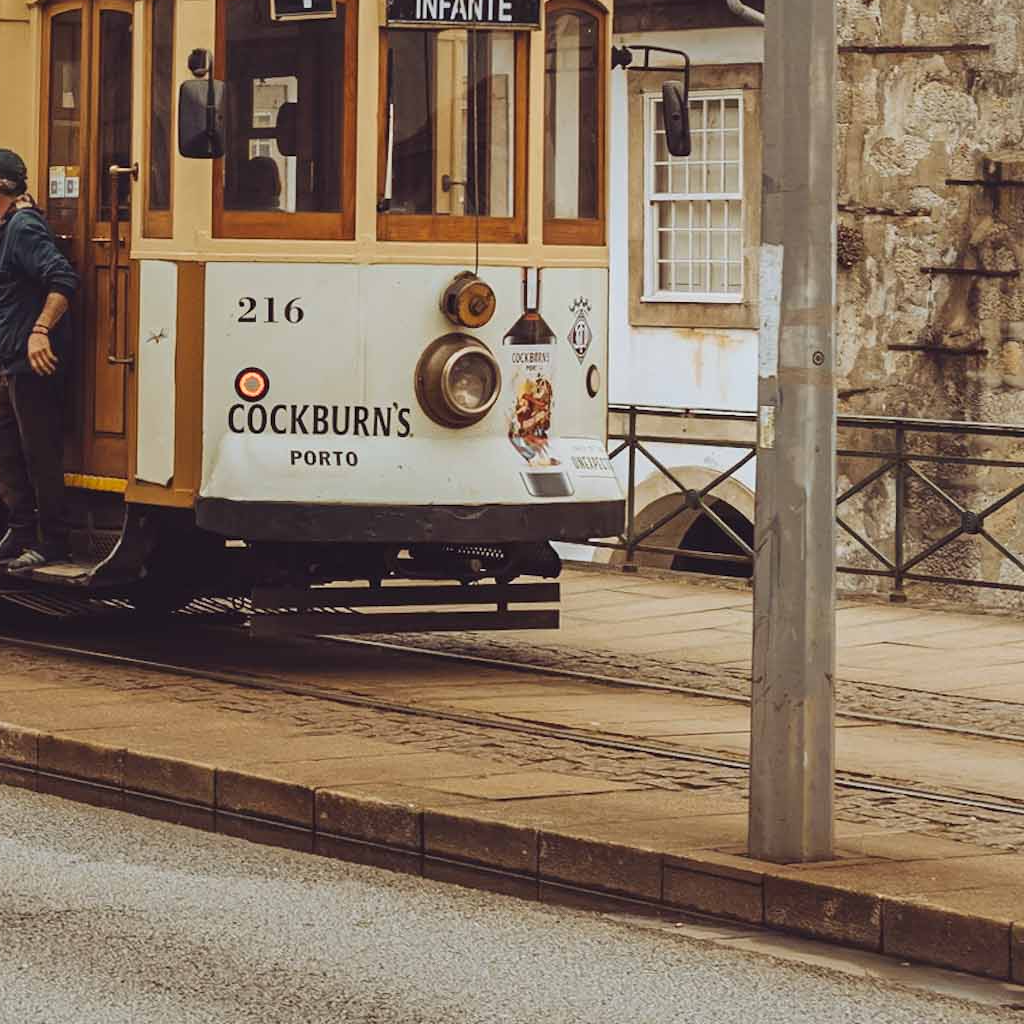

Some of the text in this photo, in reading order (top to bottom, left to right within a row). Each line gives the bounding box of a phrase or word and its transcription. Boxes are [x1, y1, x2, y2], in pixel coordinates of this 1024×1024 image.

[236, 295, 305, 325] 216
[227, 401, 412, 438] COCKBURN'S
[289, 449, 359, 467] PORTO
